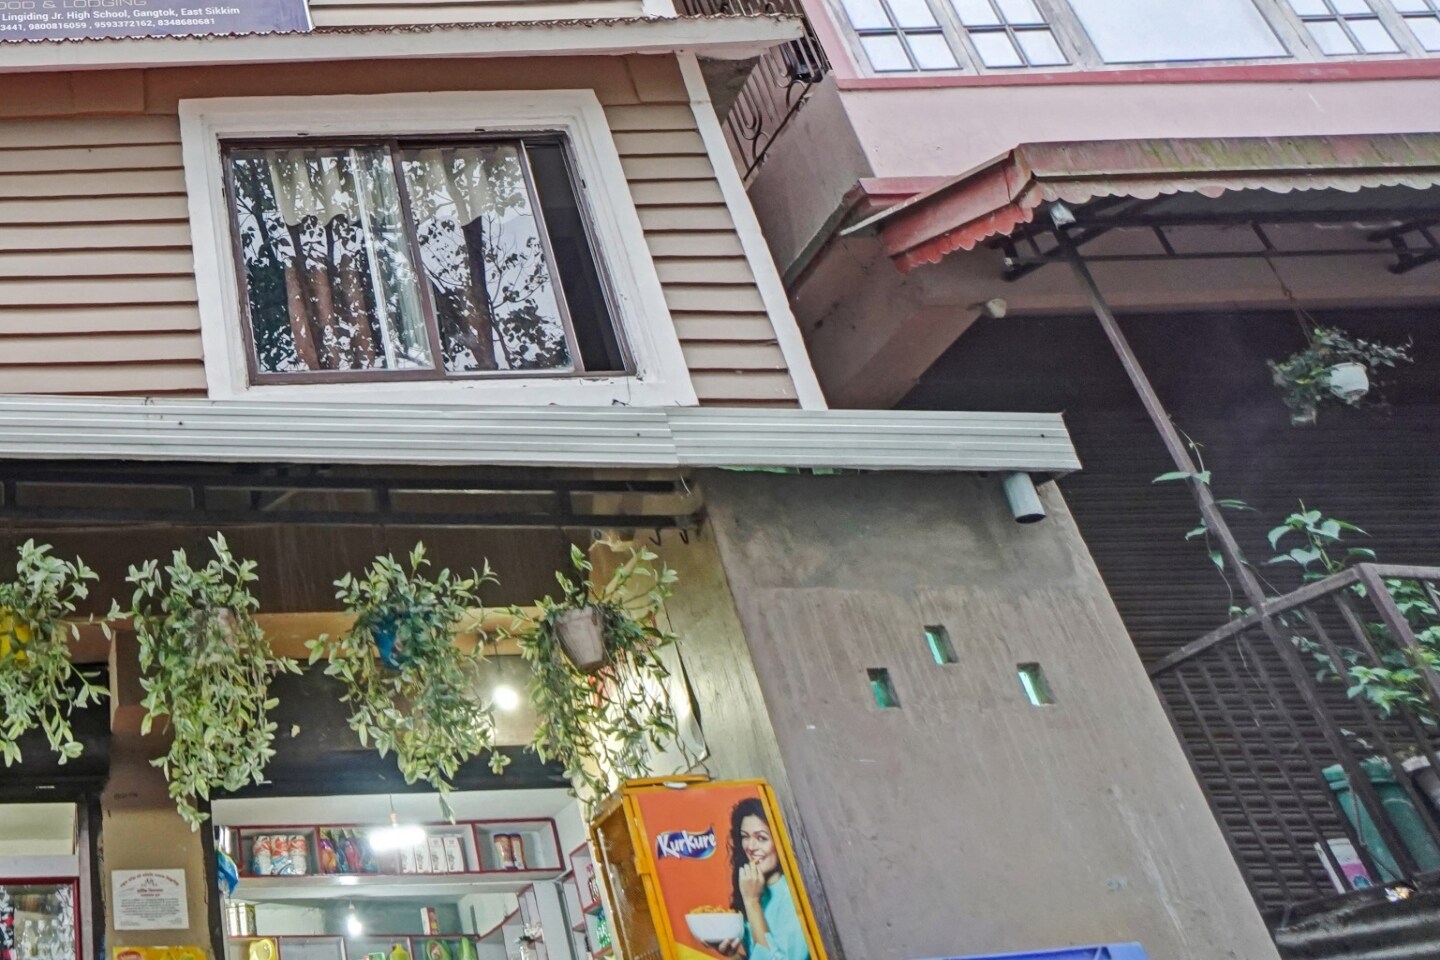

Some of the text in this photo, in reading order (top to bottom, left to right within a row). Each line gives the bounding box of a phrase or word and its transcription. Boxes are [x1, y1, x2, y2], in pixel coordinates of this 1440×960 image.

[42, 0, 56, 9] &
[2, 12, 49, 23] Lingiding
[51, 11, 63, 21] Jr.
[66, 10, 90, 21] High
[93, 9, 131, 19] School,
[133, 8, 178, 19] Gangtok,
[181, 7, 203, 16] East
[205, 6, 241, 16] Sikkim
[657, 829, 716, 858] Kurkure
